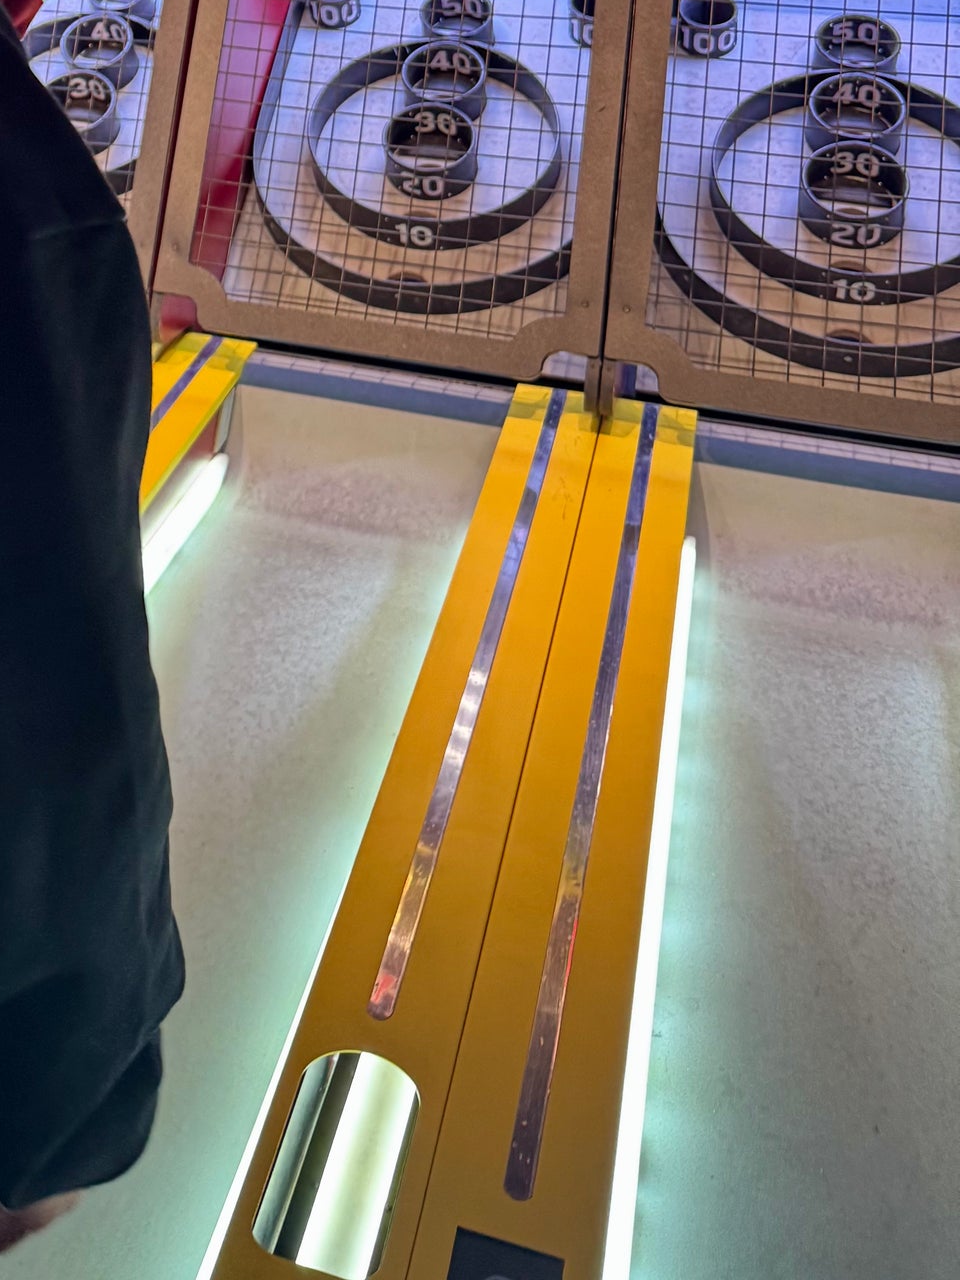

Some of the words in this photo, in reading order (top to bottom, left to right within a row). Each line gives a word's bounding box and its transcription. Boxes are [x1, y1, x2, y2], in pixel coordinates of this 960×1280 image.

[309, 0, 360, 27] 100
[91, 21, 126, 42] 40
[681, 25, 736, 55] 100
[831, 21, 880, 46] 50
[431, 50, 472, 75] 40
[69, 77, 106, 101] 30
[831, 82, 882, 108] 40
[414, 111, 458, 137] 30
[830, 151, 880, 178] 30
[400, 170, 444, 197] 20
[395, 223, 433, 247] 10
[830, 222, 882, 246] 20
[833, 278, 877, 302] 10
